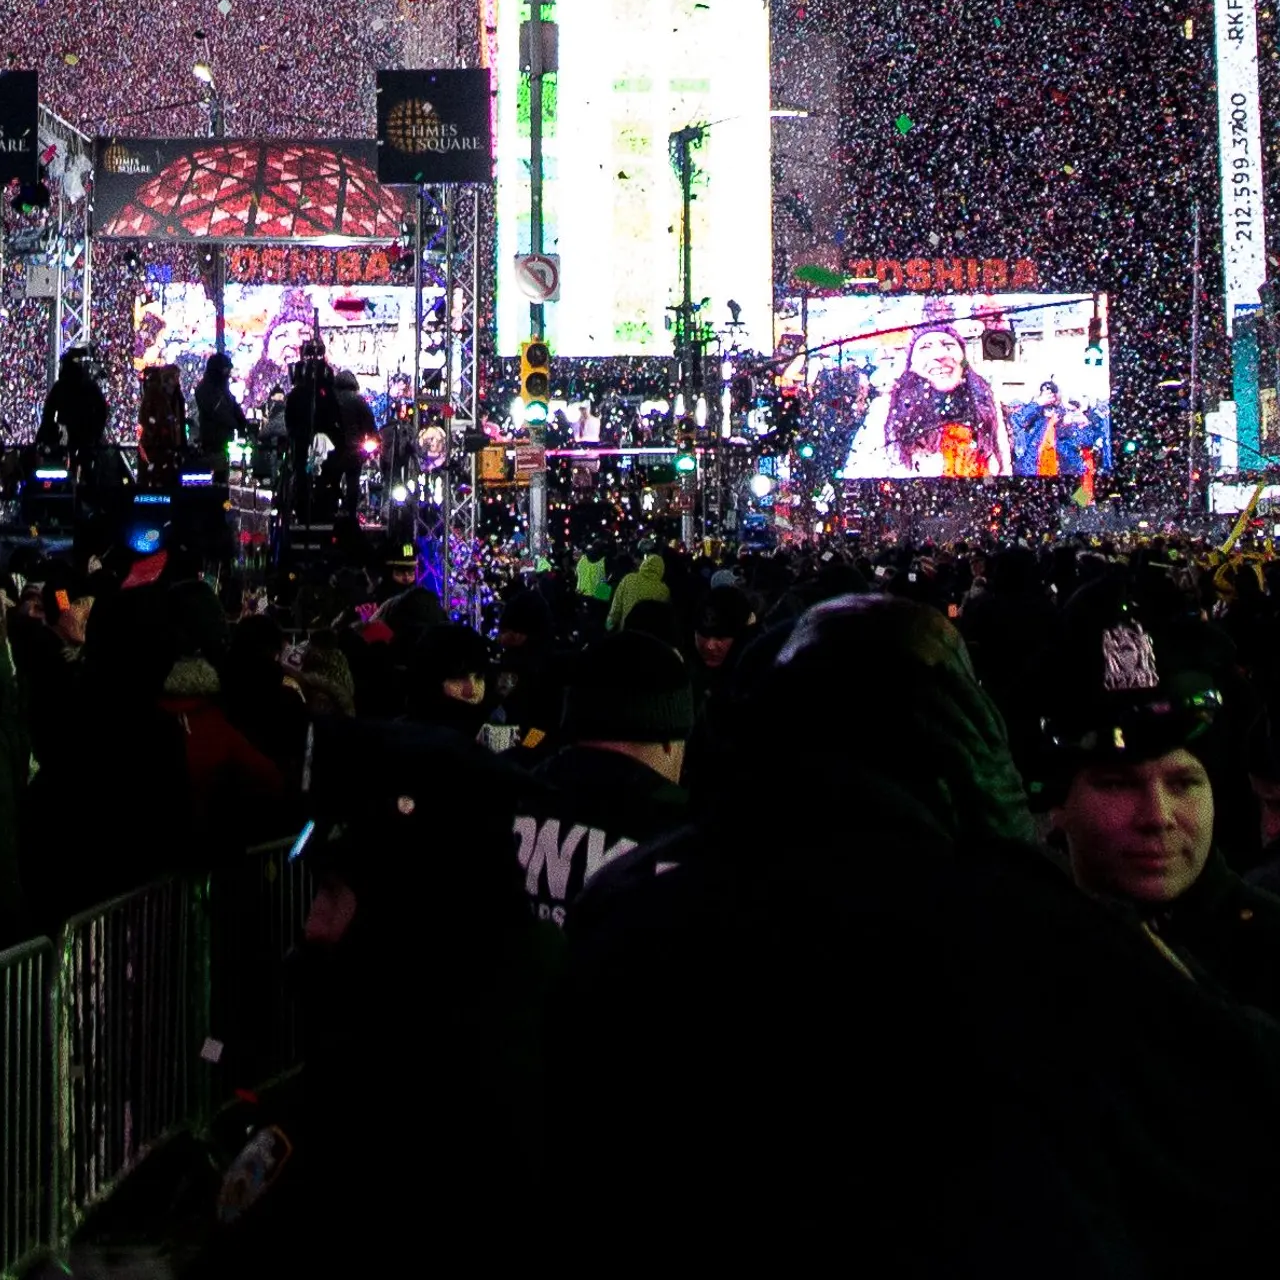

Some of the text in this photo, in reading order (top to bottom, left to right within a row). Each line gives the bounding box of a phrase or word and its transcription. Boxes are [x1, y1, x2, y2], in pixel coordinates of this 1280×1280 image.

[410, 123, 459, 138] TIMES
[415, 137, 484, 154] SQUARE
[230, 245, 391, 283] OSHIBA
[848, 257, 1039, 291] TOSHIBA
